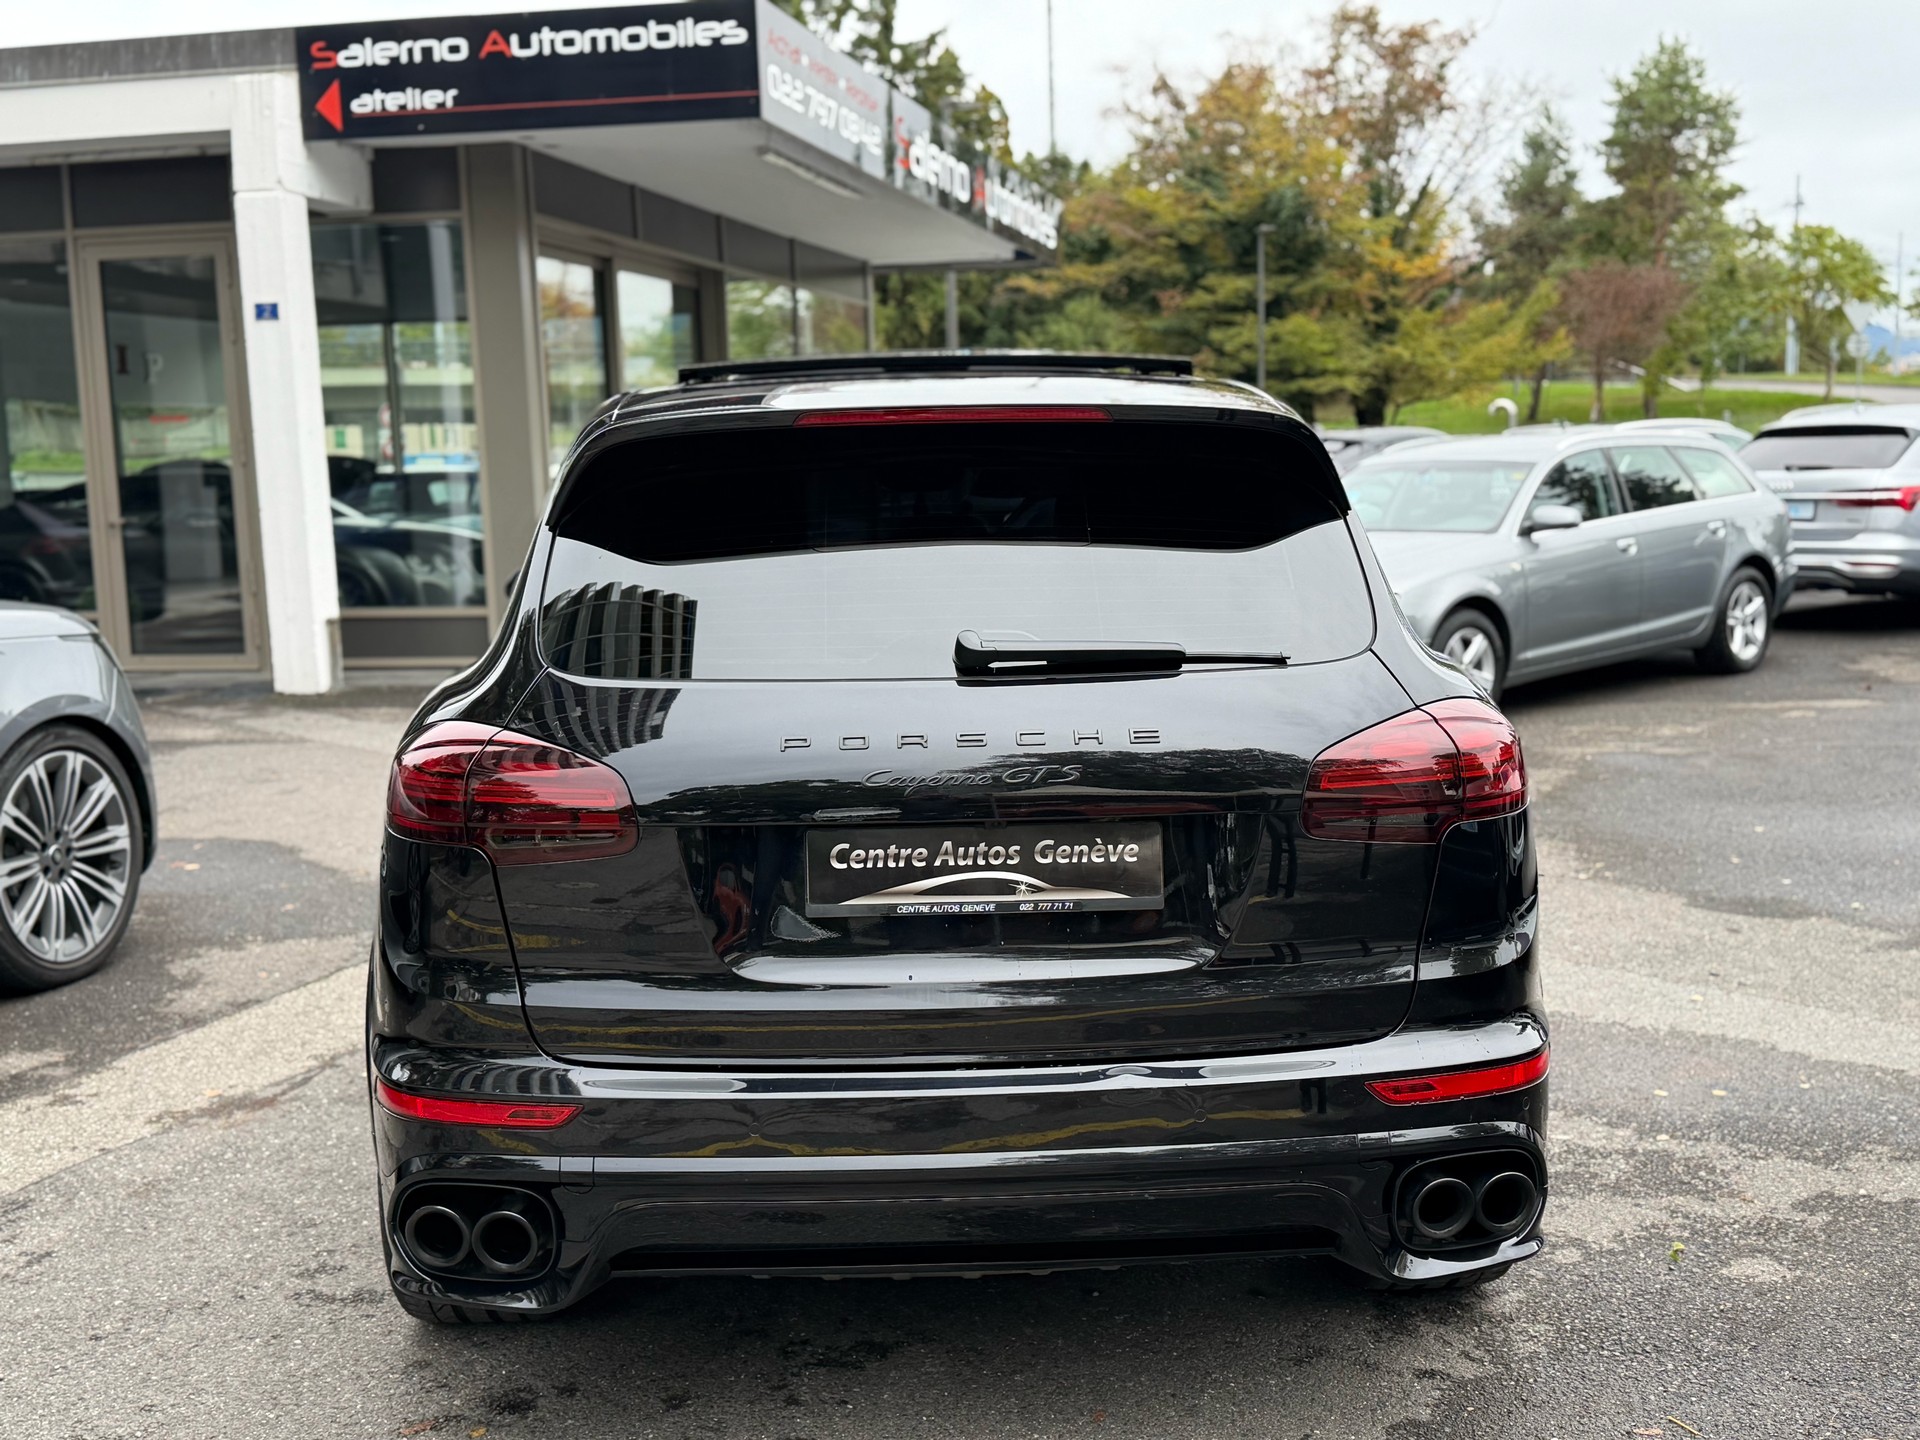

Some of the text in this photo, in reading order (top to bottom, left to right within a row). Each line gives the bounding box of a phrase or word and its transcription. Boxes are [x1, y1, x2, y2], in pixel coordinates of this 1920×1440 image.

[310, 17, 749, 70] Salerno Automobiles
[350, 87, 459, 115] atelier
[779, 728, 1162, 752] PORSCHE
[862, 765, 1083, 797] Cayenne GTS
[829, 838, 1140, 870] Centre Autos Genève
[897, 905, 931, 913] CENTRE
[931, 904, 960, 913] AUTOS
[961, 904, 996, 912] GENEVE
[1019, 903, 1034, 911] 022
[1037, 903, 1053, 911] 777
[1064, 902, 1074, 910] 71
